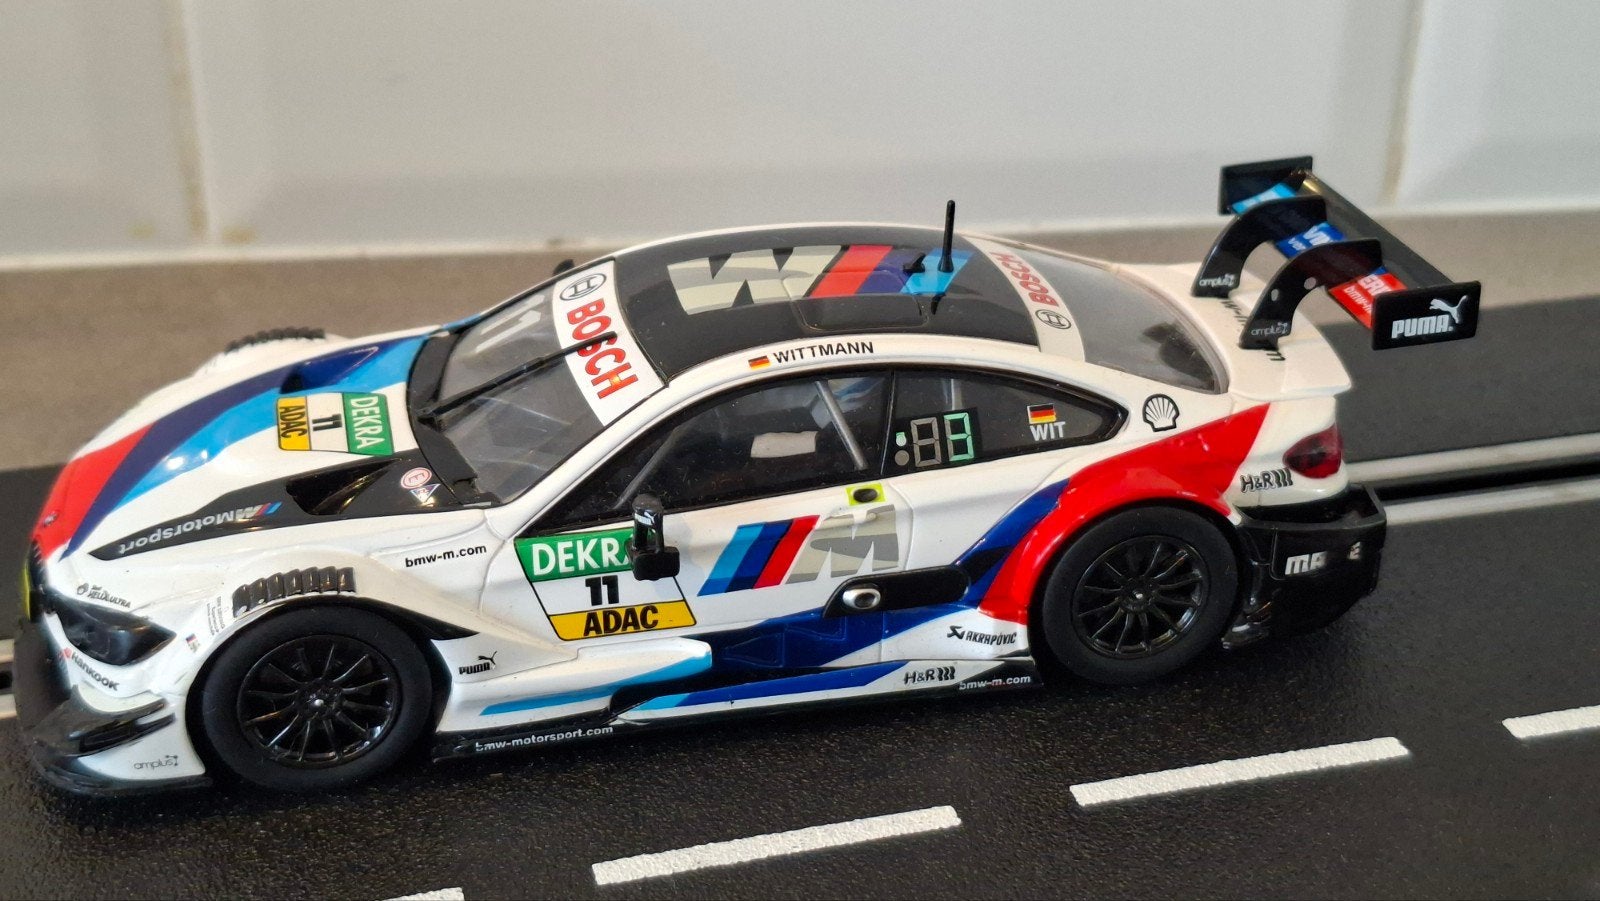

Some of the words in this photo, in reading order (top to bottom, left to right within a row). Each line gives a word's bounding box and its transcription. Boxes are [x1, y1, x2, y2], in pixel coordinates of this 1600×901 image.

[988, 252, 1059, 307] BOSCH
[773, 341, 874, 364] WITTMANN
[279, 405, 308, 439] ADAC
[311, 413, 343, 432] 11
[350, 396, 386, 450] DEKRA
[1029, 421, 1067, 442] WIT
[405, 544, 487, 569] bmw-m.com
[585, 575, 620, 607] 11
[583, 606, 659, 637] ADAC
[459, 661, 491, 675] PUMA
[903, 668, 936, 685] H&R
[959, 675, 1031, 691] bmw-m.com
[475, 726, 614, 752] bmw-motorsport.com
